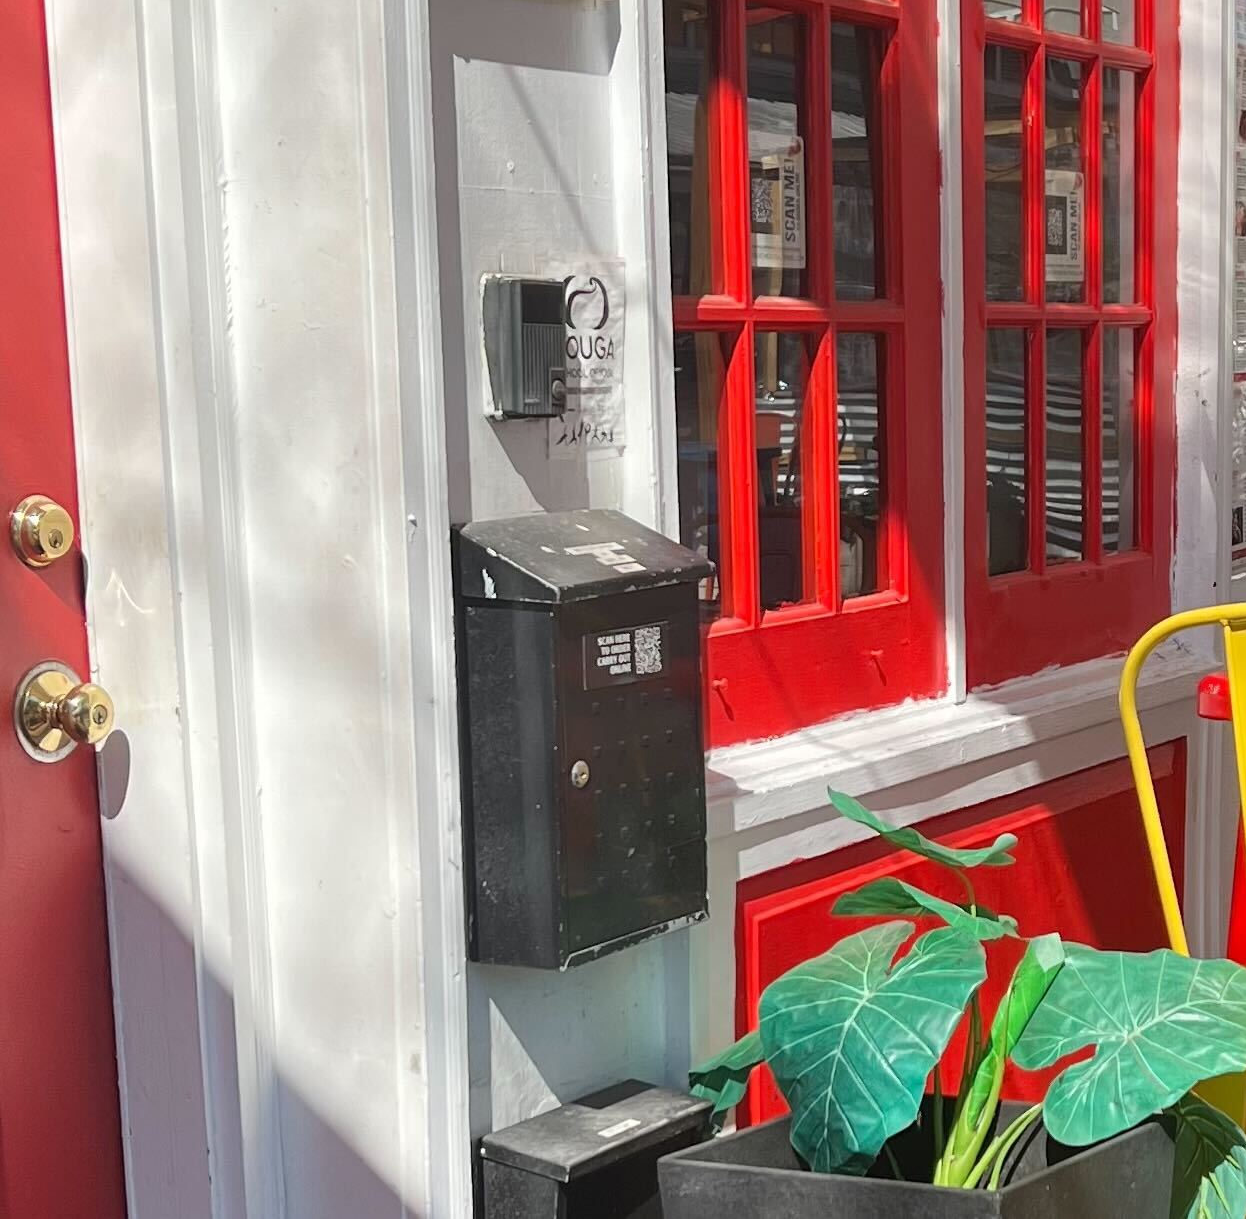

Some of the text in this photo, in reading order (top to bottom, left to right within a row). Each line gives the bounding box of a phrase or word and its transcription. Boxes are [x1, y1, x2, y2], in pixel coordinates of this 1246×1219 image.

[784, 159, 796, 242] SCAN ME!
[1070, 222, 1079, 261] SCAN
